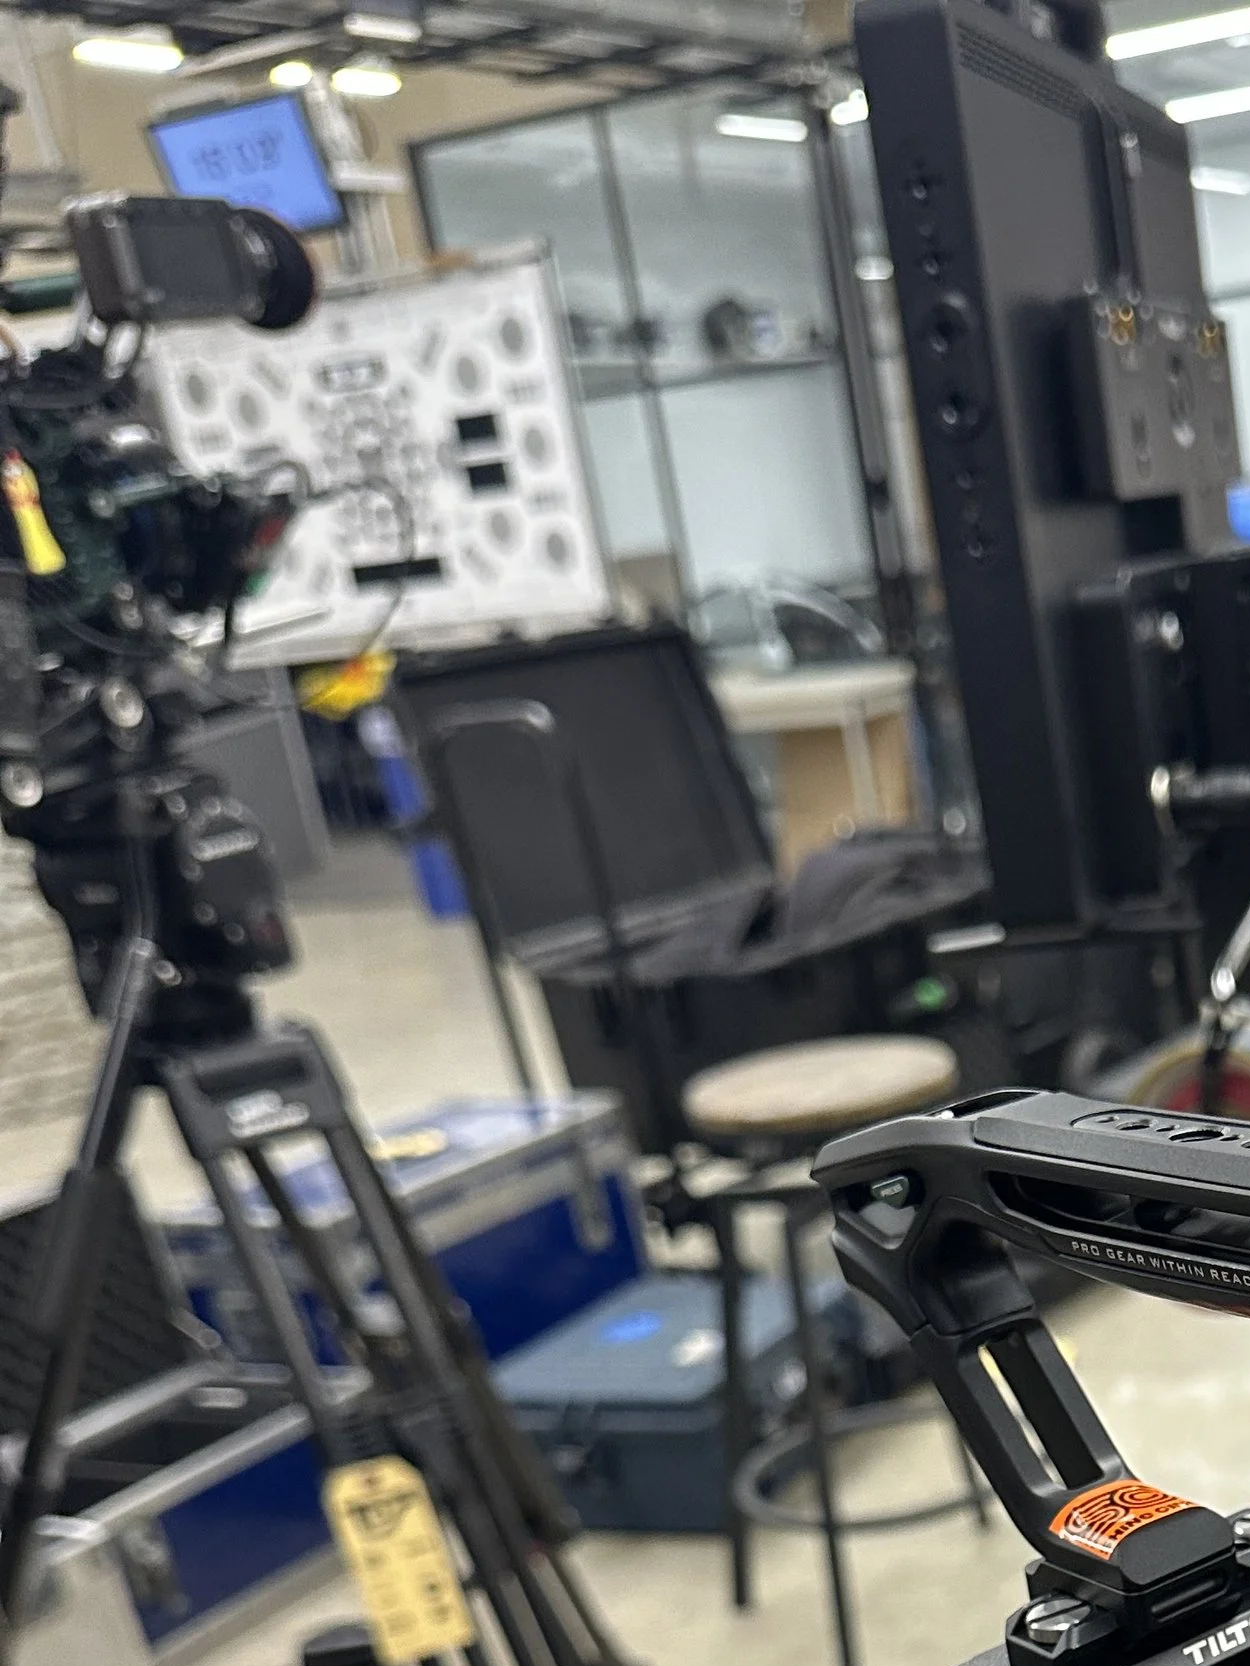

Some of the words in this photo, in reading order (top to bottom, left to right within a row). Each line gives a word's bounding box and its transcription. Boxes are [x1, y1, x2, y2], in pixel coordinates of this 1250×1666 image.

[1071, 1241, 1100, 1256] PRO
[1106, 1248, 1145, 1266] GEAR
[1149, 1256, 1205, 1278] WITHIN
